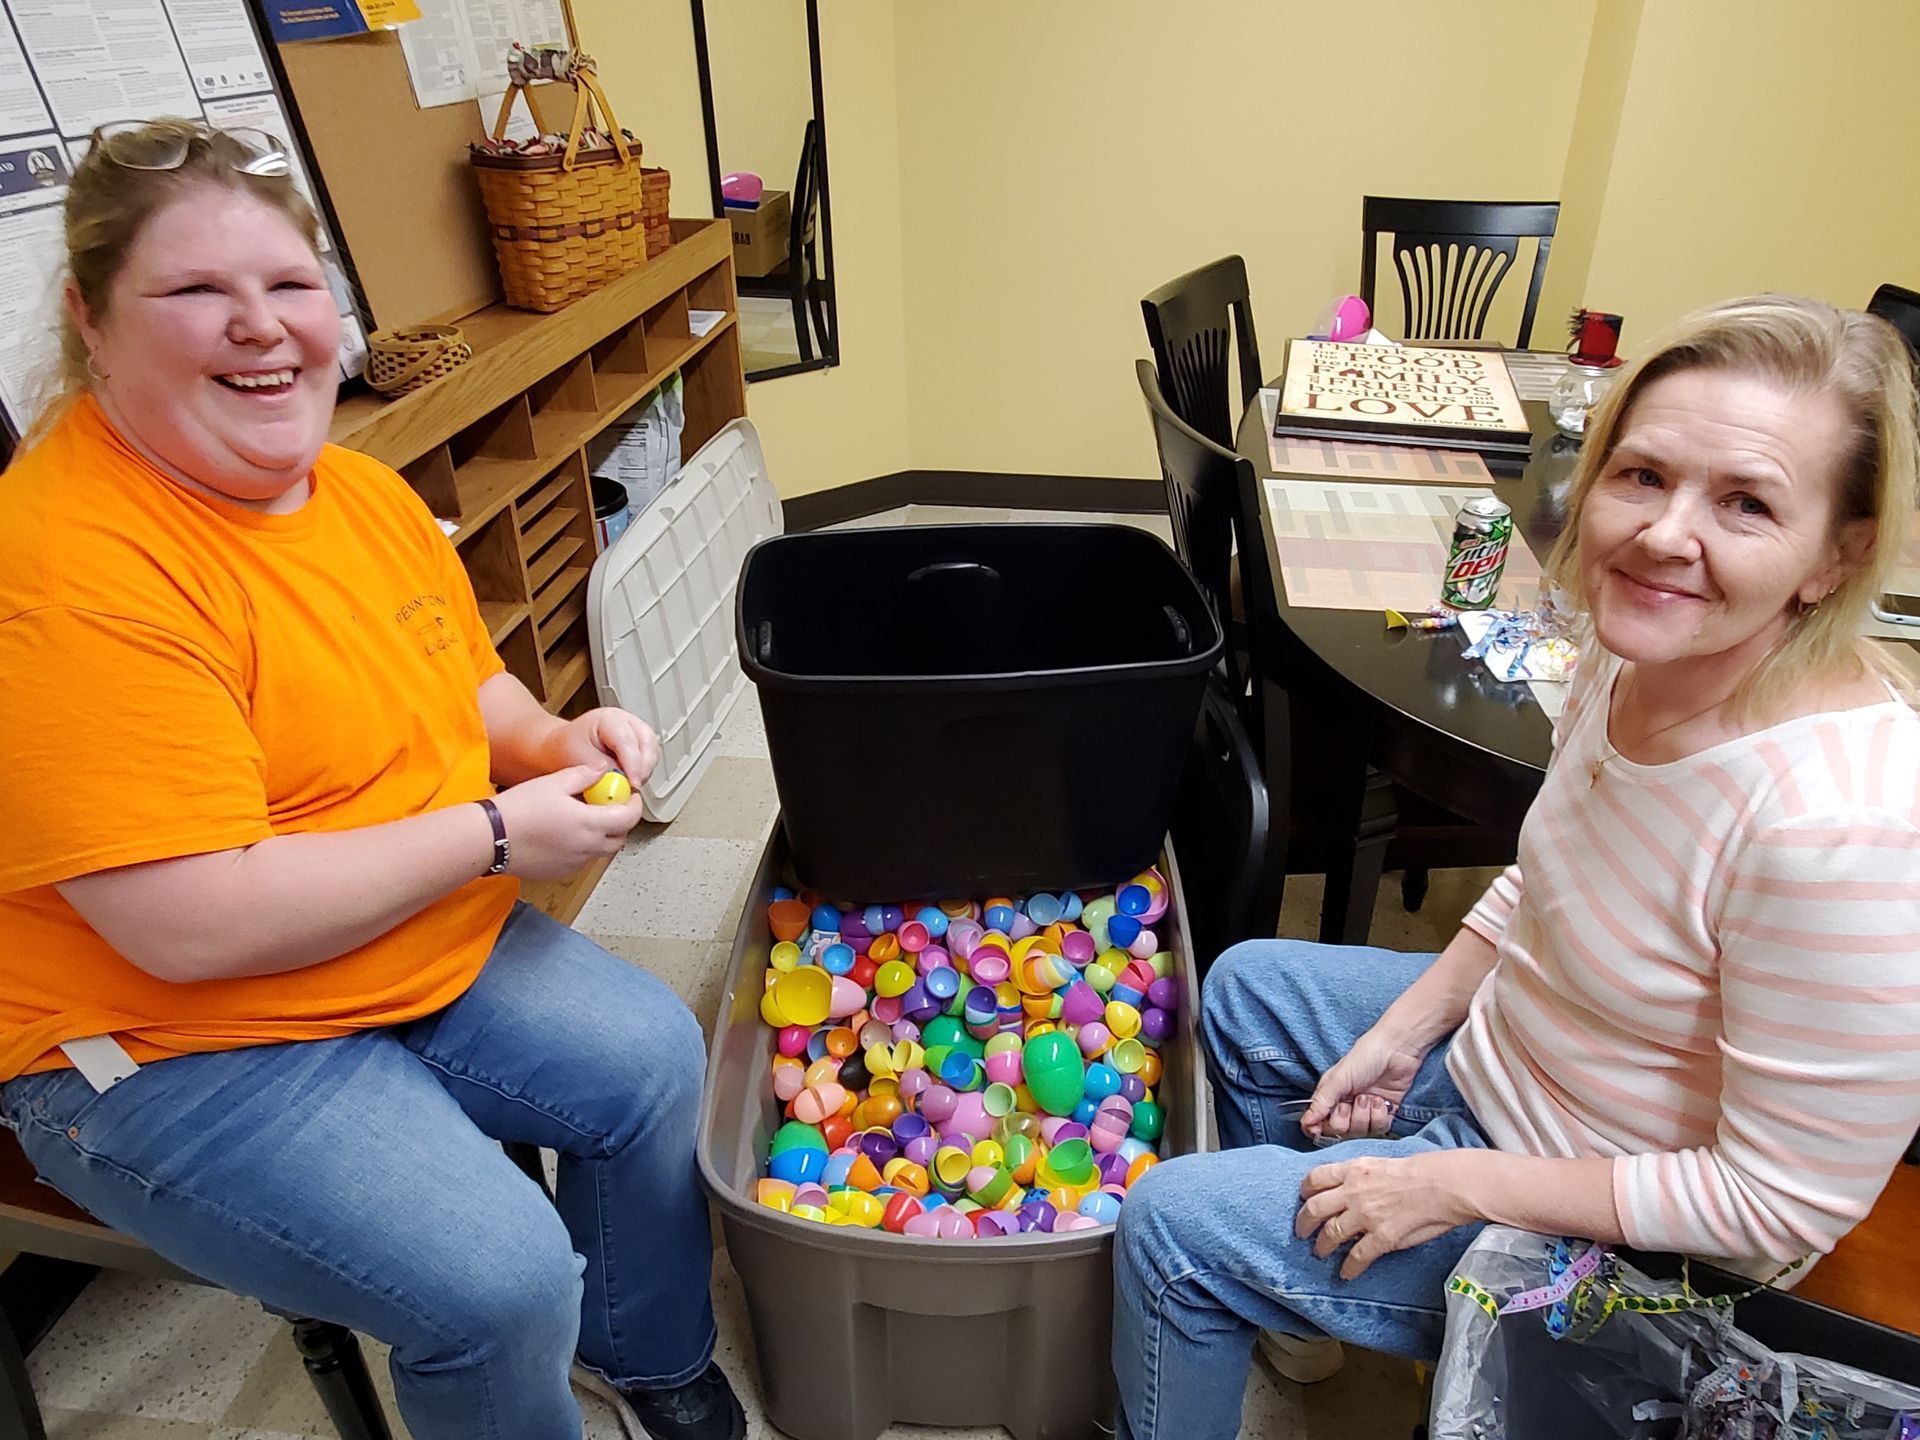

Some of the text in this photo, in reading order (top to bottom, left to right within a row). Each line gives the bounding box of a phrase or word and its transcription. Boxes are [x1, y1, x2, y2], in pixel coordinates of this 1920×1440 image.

[1311, 341, 1477, 360] Thank you
[1349, 352, 1483, 369] FOOD
[1311, 364, 1488, 386] FAMILY
[1314, 357, 1393, 370] before
[1445, 367, 1485, 375] the
[1308, 382, 1411, 400] beside
[1421, 395, 1457, 403] us
[1328, 376, 1493, 396] FRIENDS
[1303, 392, 1505, 423] LOVE
